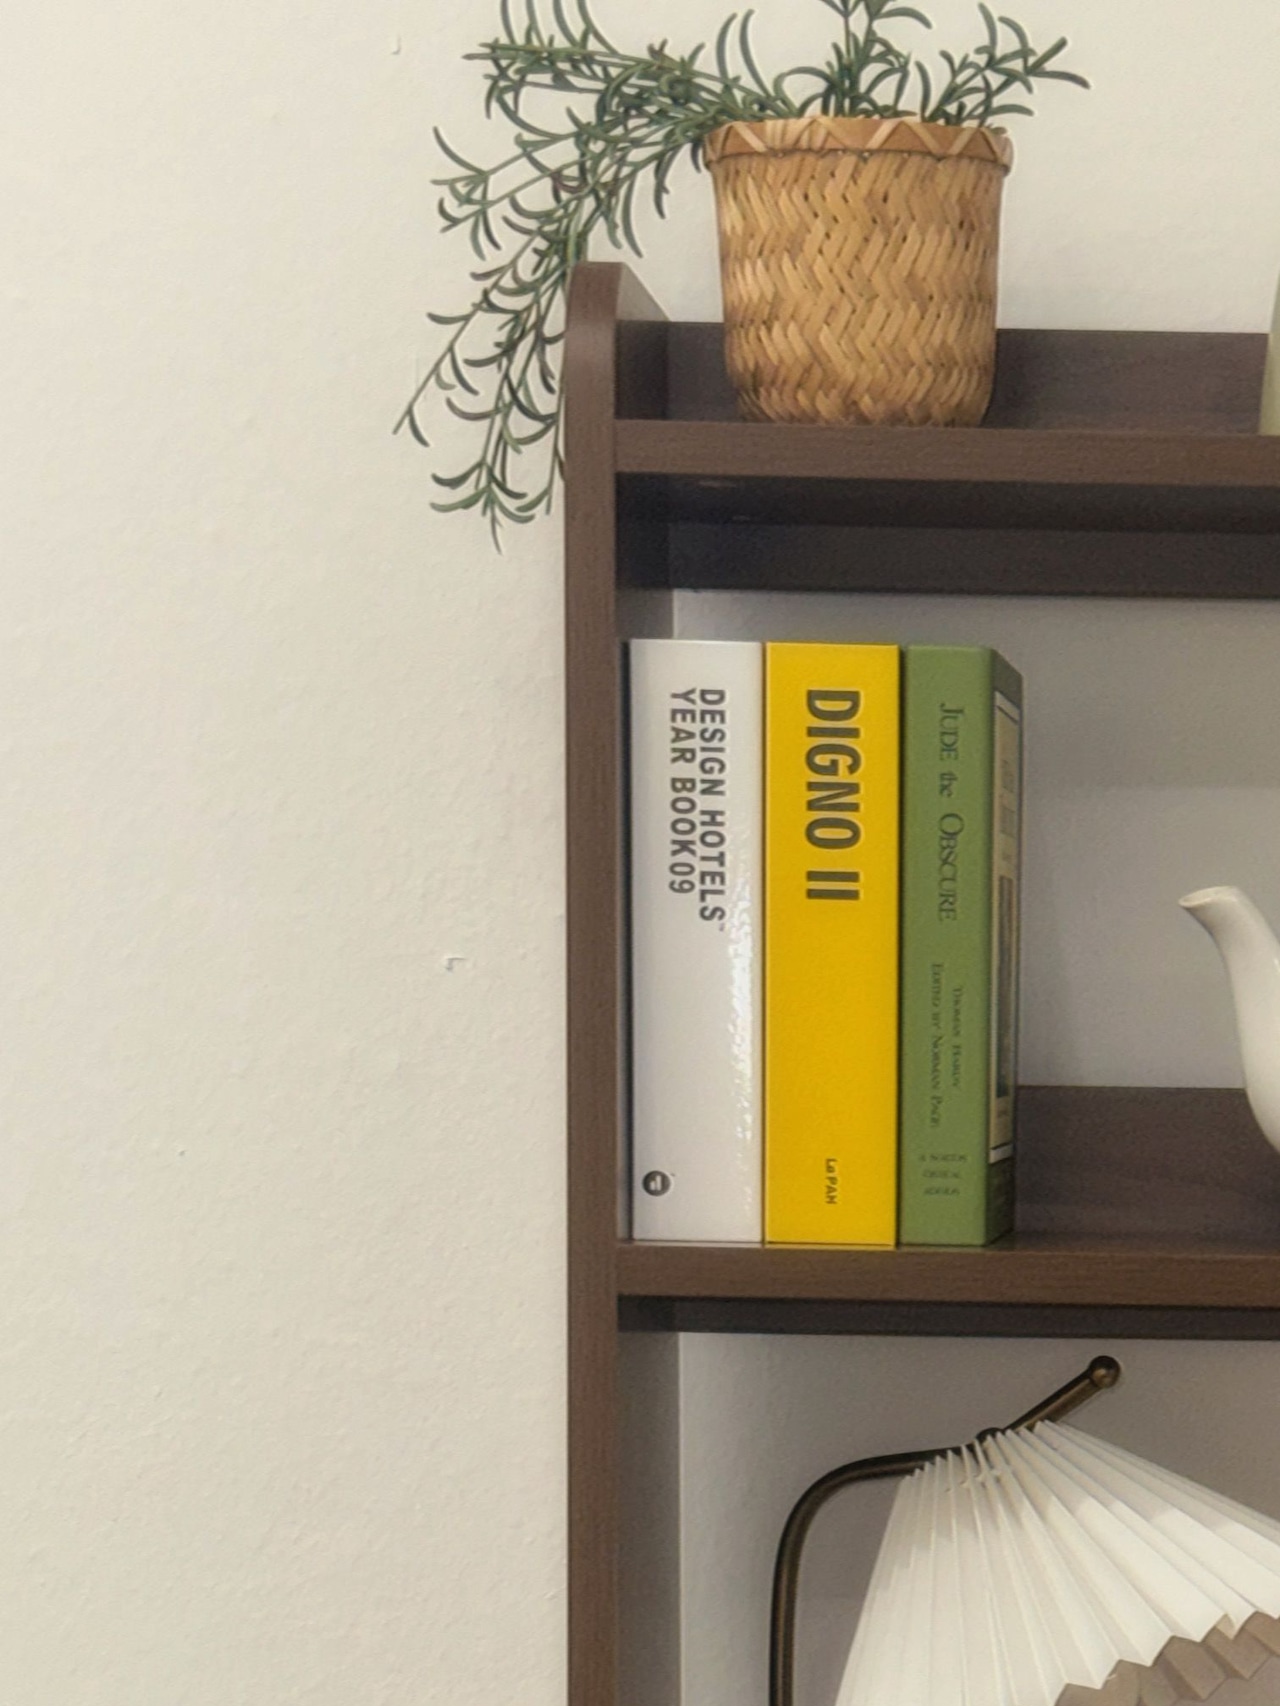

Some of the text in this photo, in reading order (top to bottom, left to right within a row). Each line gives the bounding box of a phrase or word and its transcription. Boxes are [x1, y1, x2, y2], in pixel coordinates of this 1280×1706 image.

[670, 686, 697, 765] YEAR
[699, 688, 726, 797] DESIGN
[805, 689, 861, 901] DIGNO II
[937, 702, 965, 923] JUDE the OBSCURE
[930, 1036, 944, 1091] NORMAN
